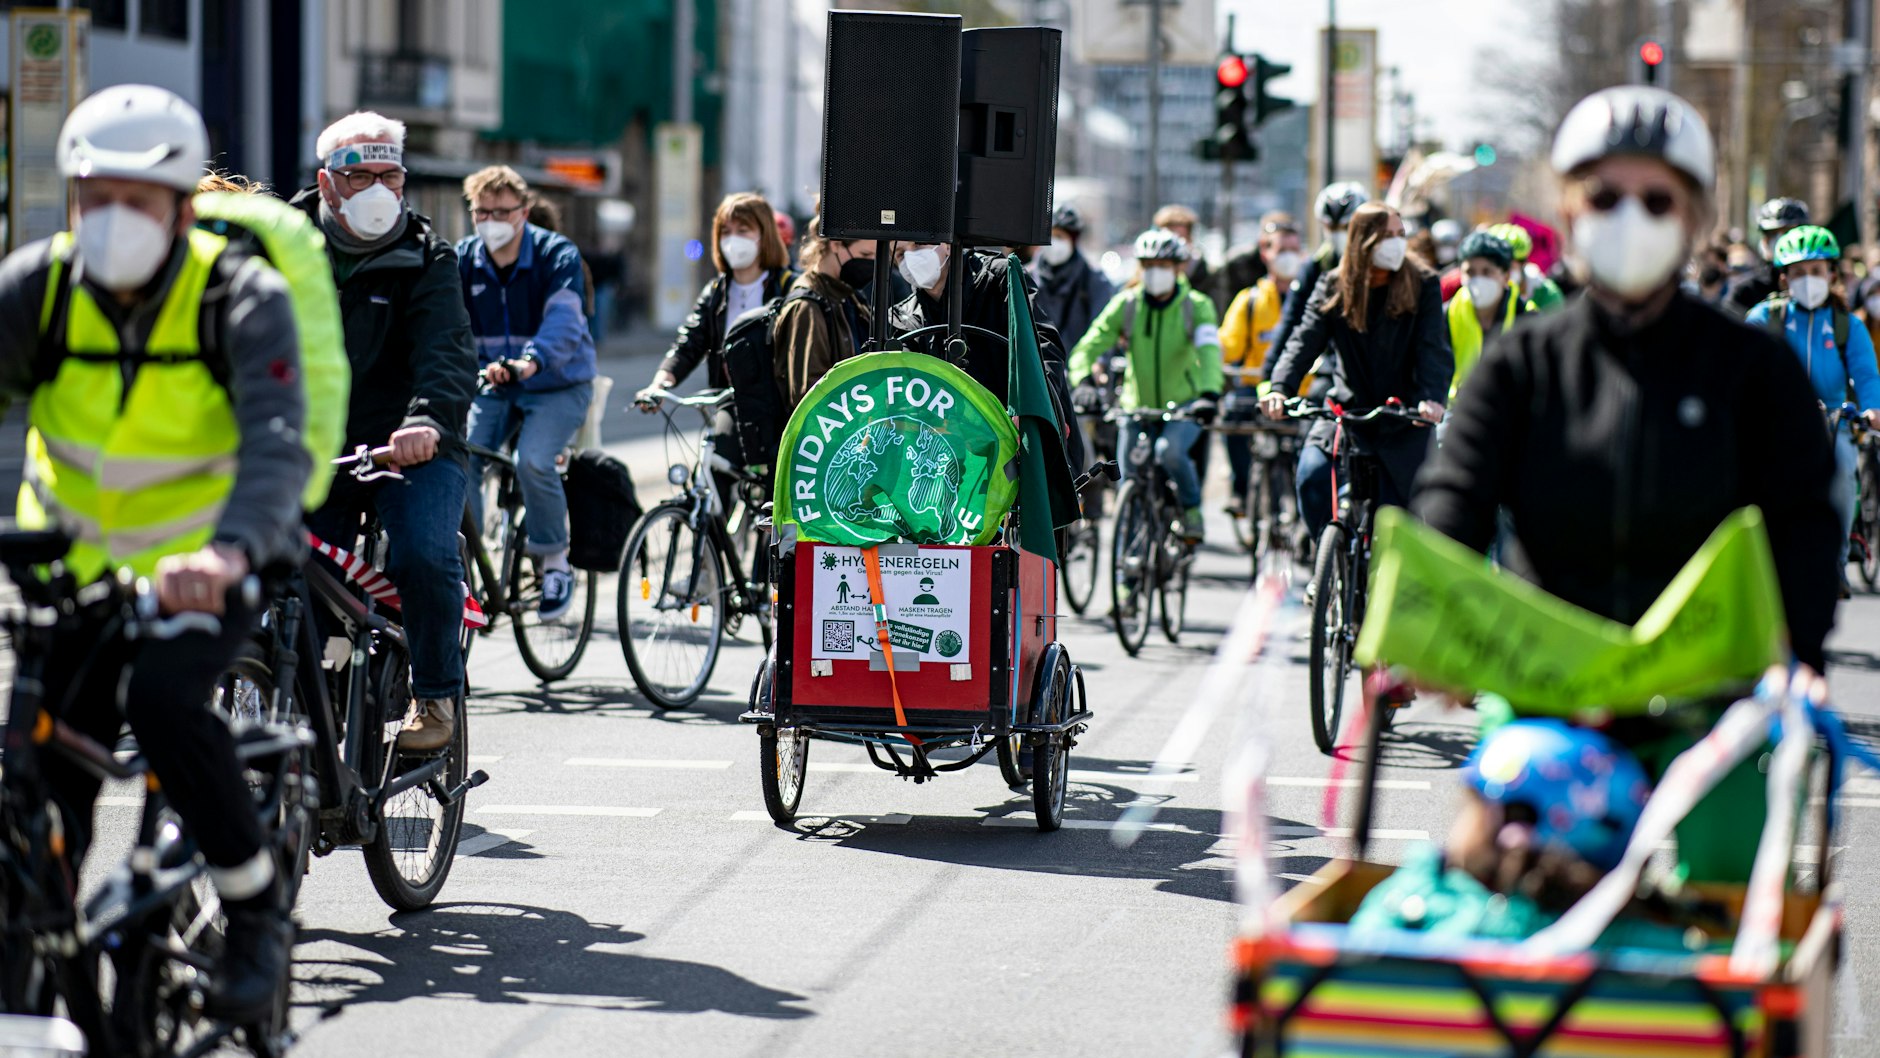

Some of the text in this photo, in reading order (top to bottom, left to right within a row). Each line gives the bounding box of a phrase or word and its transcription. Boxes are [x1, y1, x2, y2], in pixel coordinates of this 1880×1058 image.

[363, 145, 388, 153] TEMPO
[795, 375, 955, 524] FRIDAYS FOR
[841, 555, 959, 570] HYENEREGELN
[925, 569, 944, 577] Virus!
[894, 623, 930, 638] vollständige
[901, 637, 911, 646] ihr
[911, 641, 924, 650] hier
